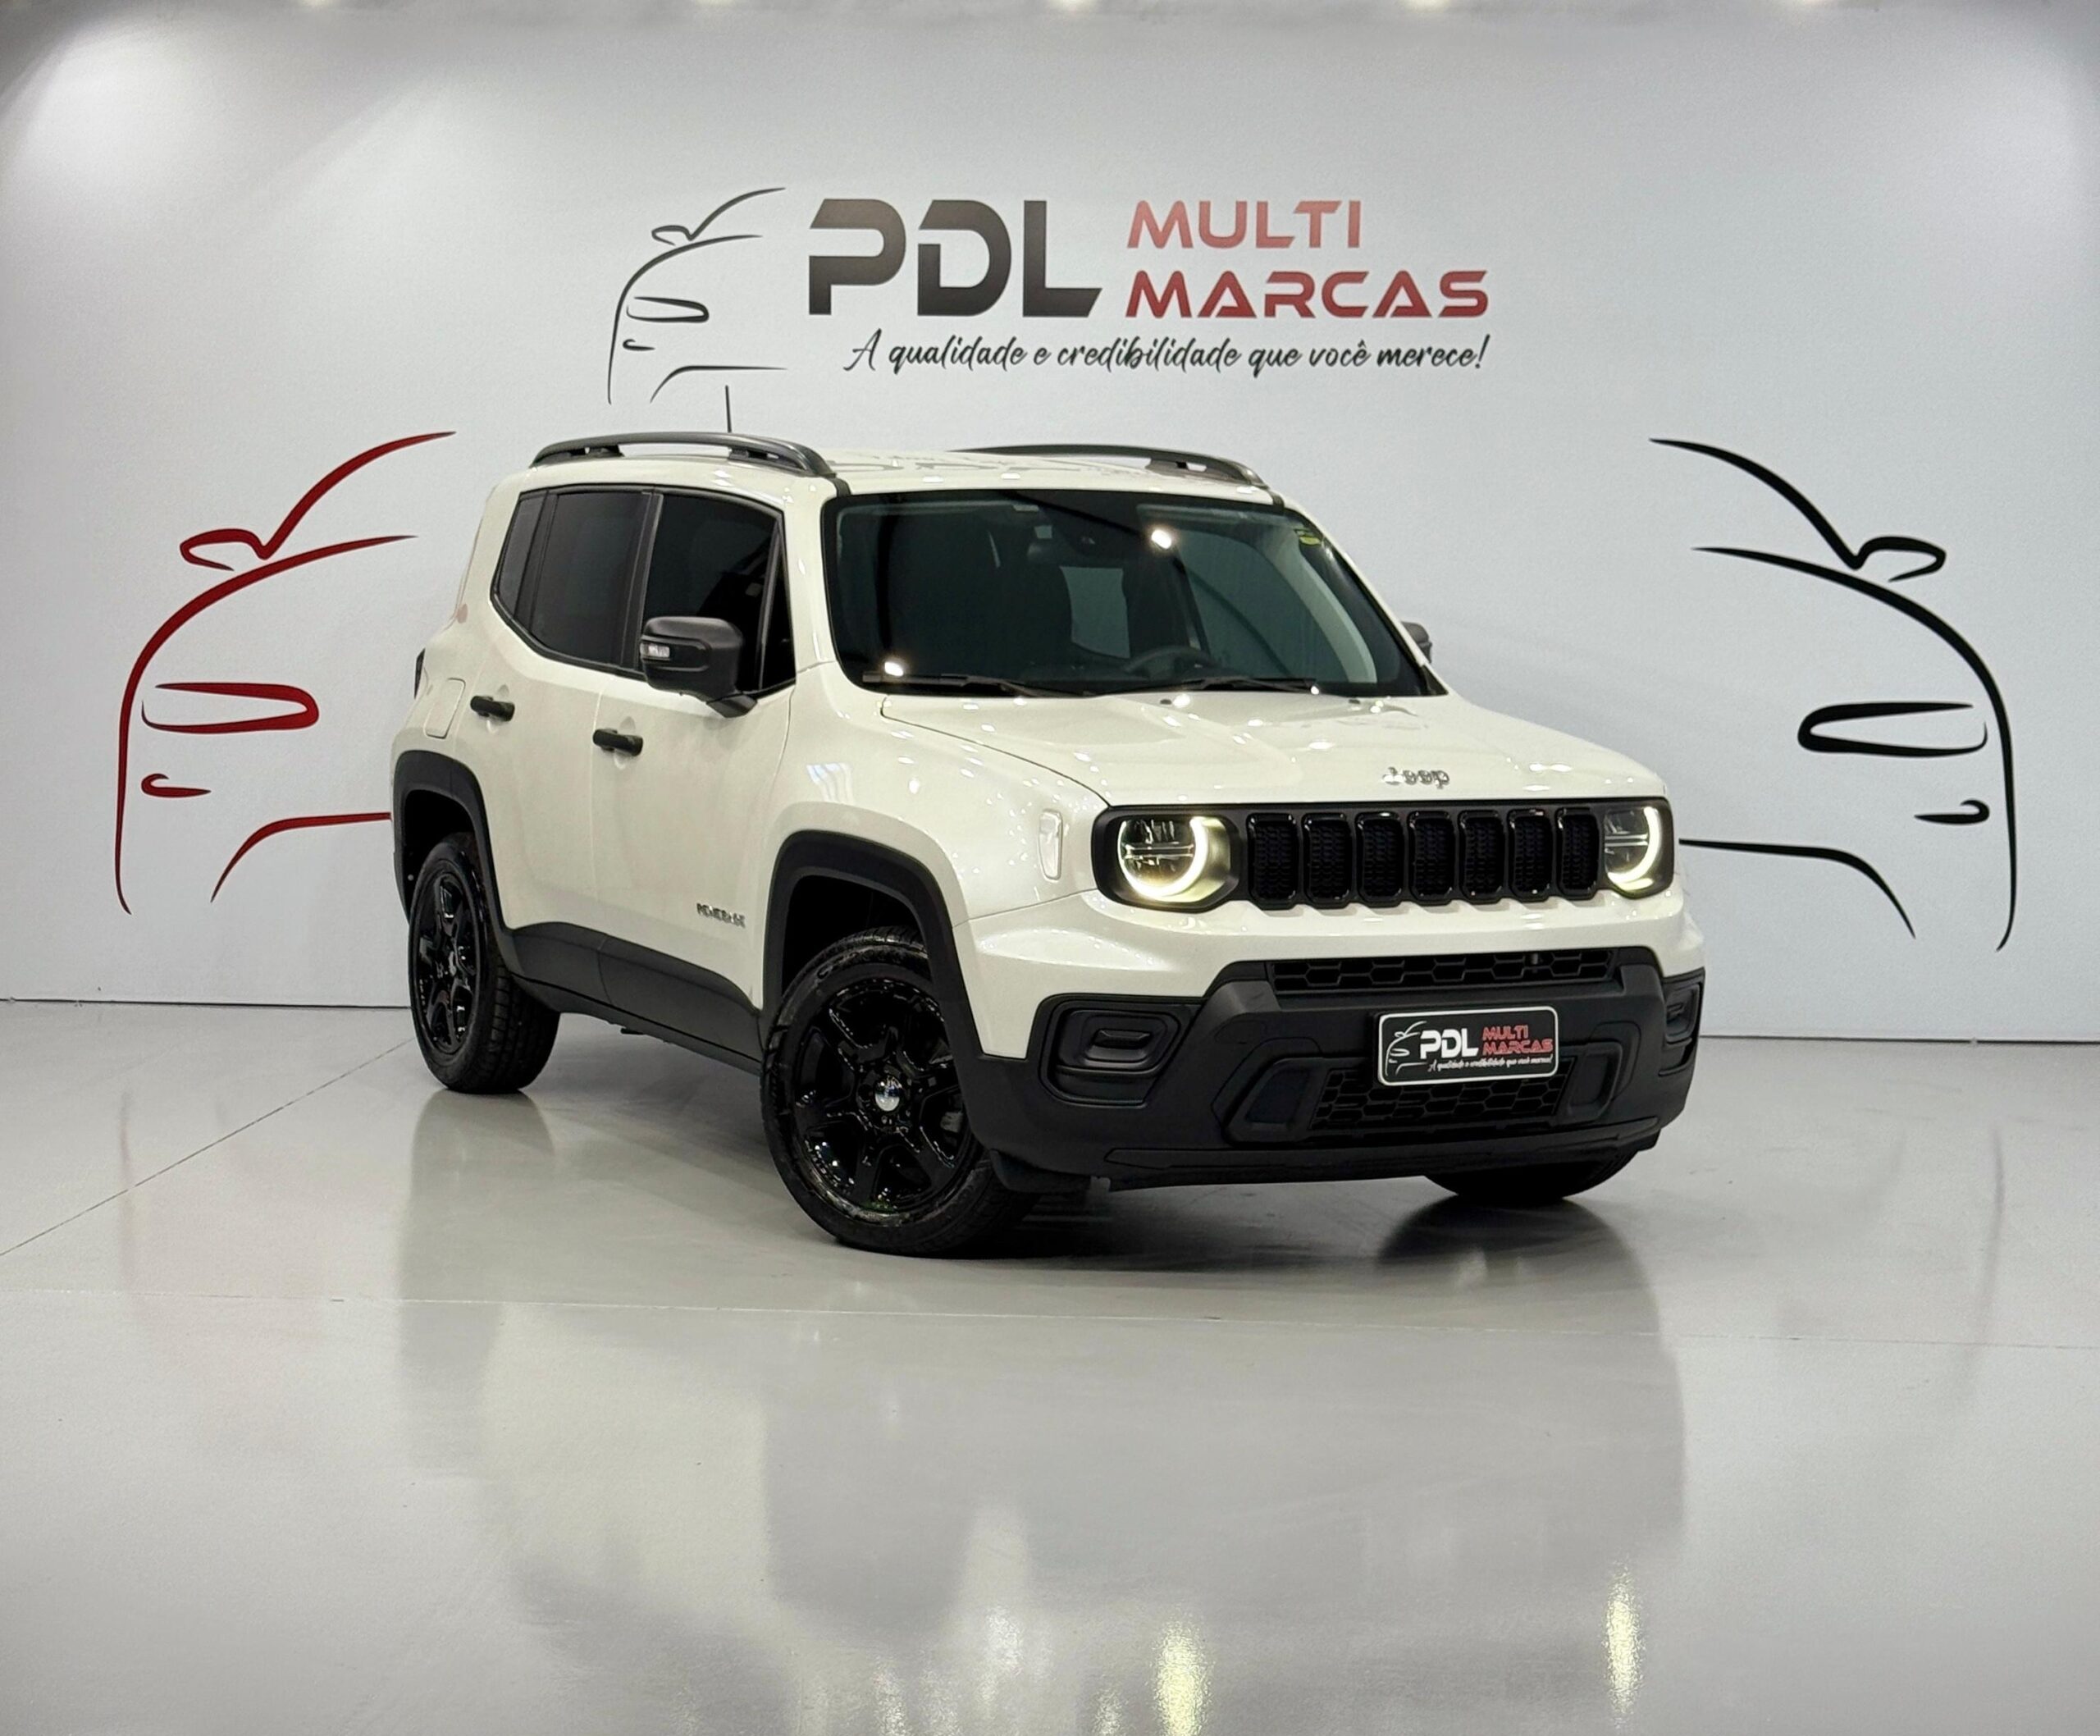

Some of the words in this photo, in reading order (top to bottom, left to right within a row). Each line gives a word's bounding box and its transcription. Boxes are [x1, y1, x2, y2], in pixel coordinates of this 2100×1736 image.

[1126, 200, 1362, 249] MULTI
[809, 198, 1102, 318] PDL
[1125, 269, 1489, 318] MARCAS
[842, 328, 883, 371] A
[888, 335, 1028, 375] qualidade
[1033, 346, 1052, 365] e
[1057, 336, 1242, 373] credibilidade
[1248, 347, 1303, 378] que
[1309, 340, 1372, 368] você
[1376, 334, 1491, 369] merece!
[1419, 1028, 1479, 1060] PDL
[1481, 1039, 1554, 1056] MARCAS
[1482, 1024, 1529, 1041] MULTI
